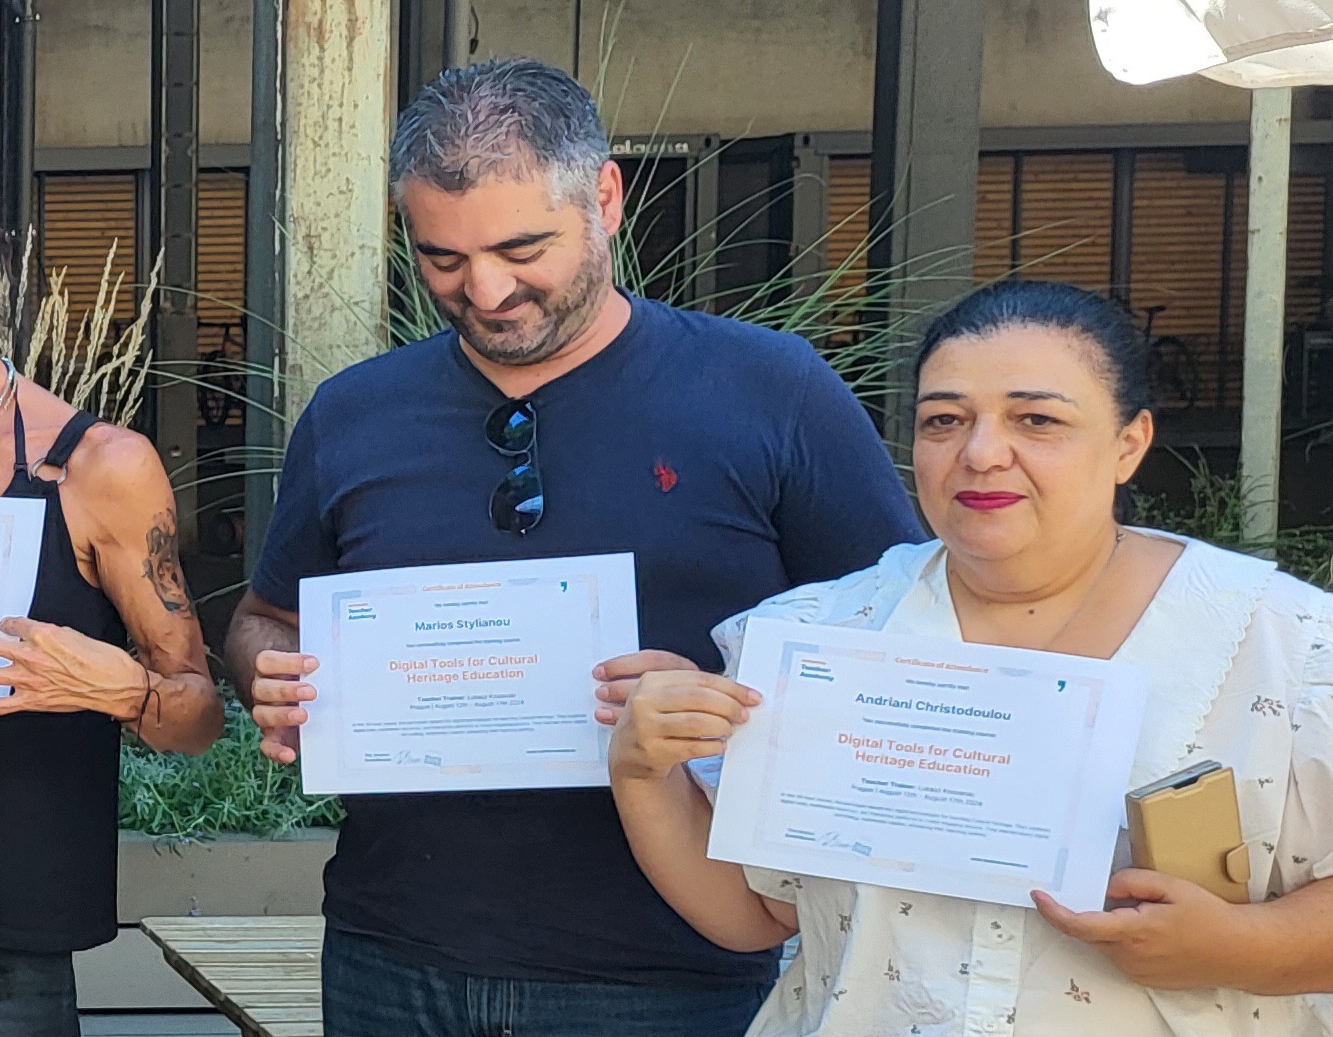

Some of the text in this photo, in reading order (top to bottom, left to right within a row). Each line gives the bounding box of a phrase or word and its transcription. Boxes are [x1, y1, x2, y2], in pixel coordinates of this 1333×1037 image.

[415, 618, 510, 631] Marios Stylianou
[390, 654, 537, 672] Digital Tools for Cultural
[407, 669, 523, 684] Heritage Education
[855, 693, 1011, 720] Andriani Christodoulou
[838, 733, 1010, 764] Digital Tools for Cultural
[855, 750, 990, 777] Heritage Education
